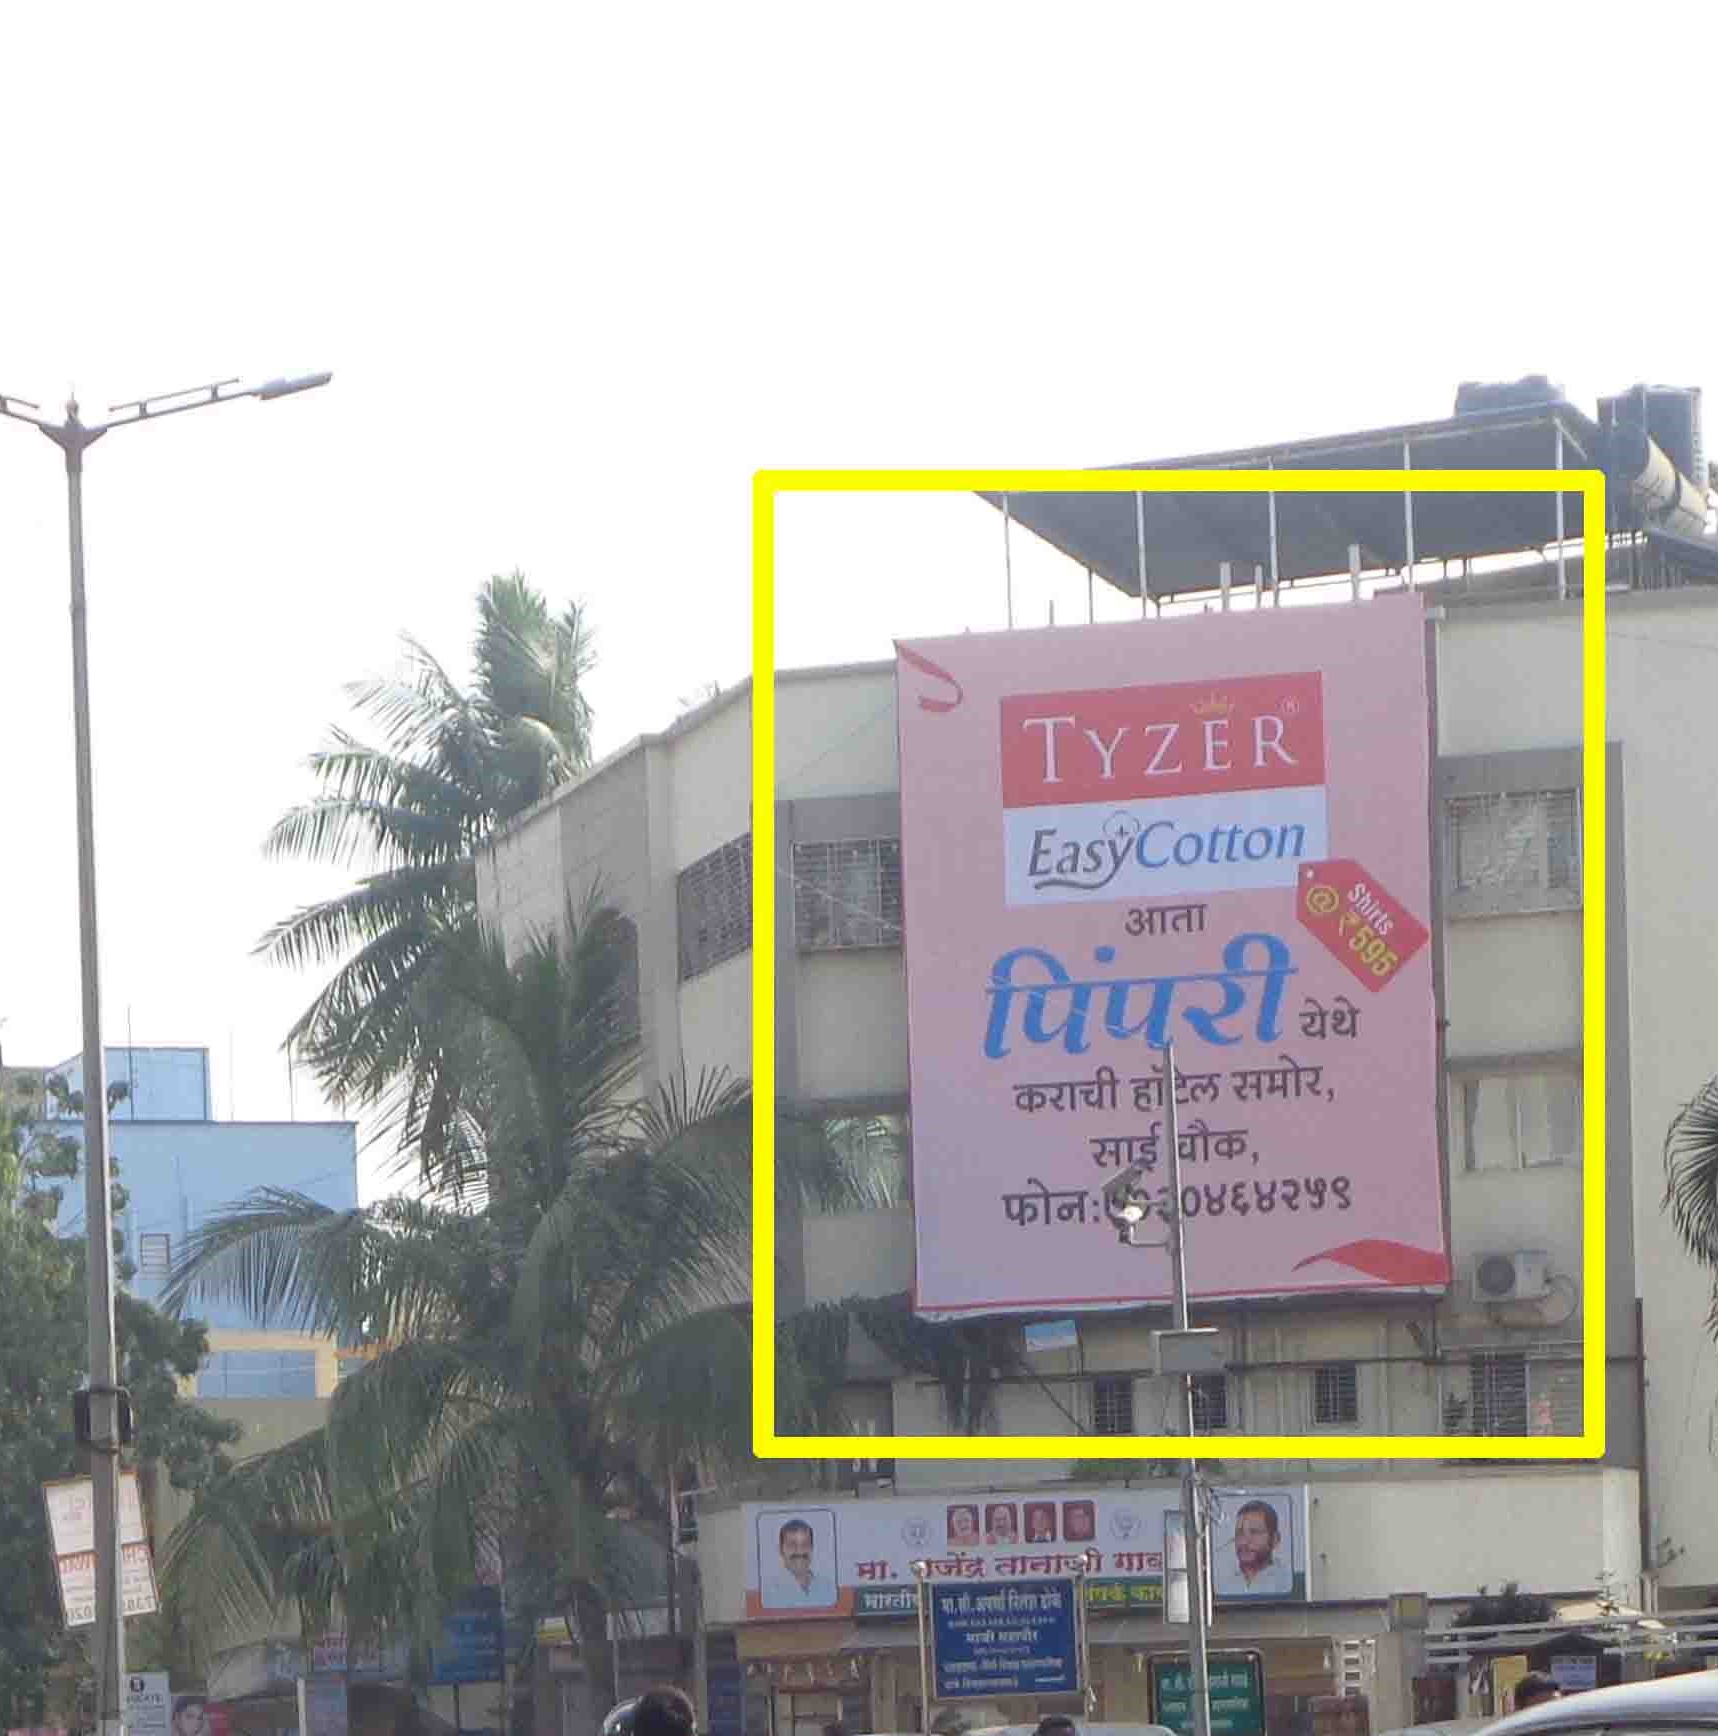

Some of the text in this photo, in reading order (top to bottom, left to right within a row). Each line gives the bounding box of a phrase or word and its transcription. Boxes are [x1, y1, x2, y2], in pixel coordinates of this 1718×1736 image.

[1022, 713, 1299, 783] TYZER
[1125, 903, 1208, 937] आता
[1347, 880, 1394, 935] Shirts
[984, 933, 1360, 1058] पिंपरी येथे
[1012, 1066, 1119, 1112] कराची
[1231, 1055, 1335, 1101] समोर,
[1090, 1121, 1162, 1171] साई
